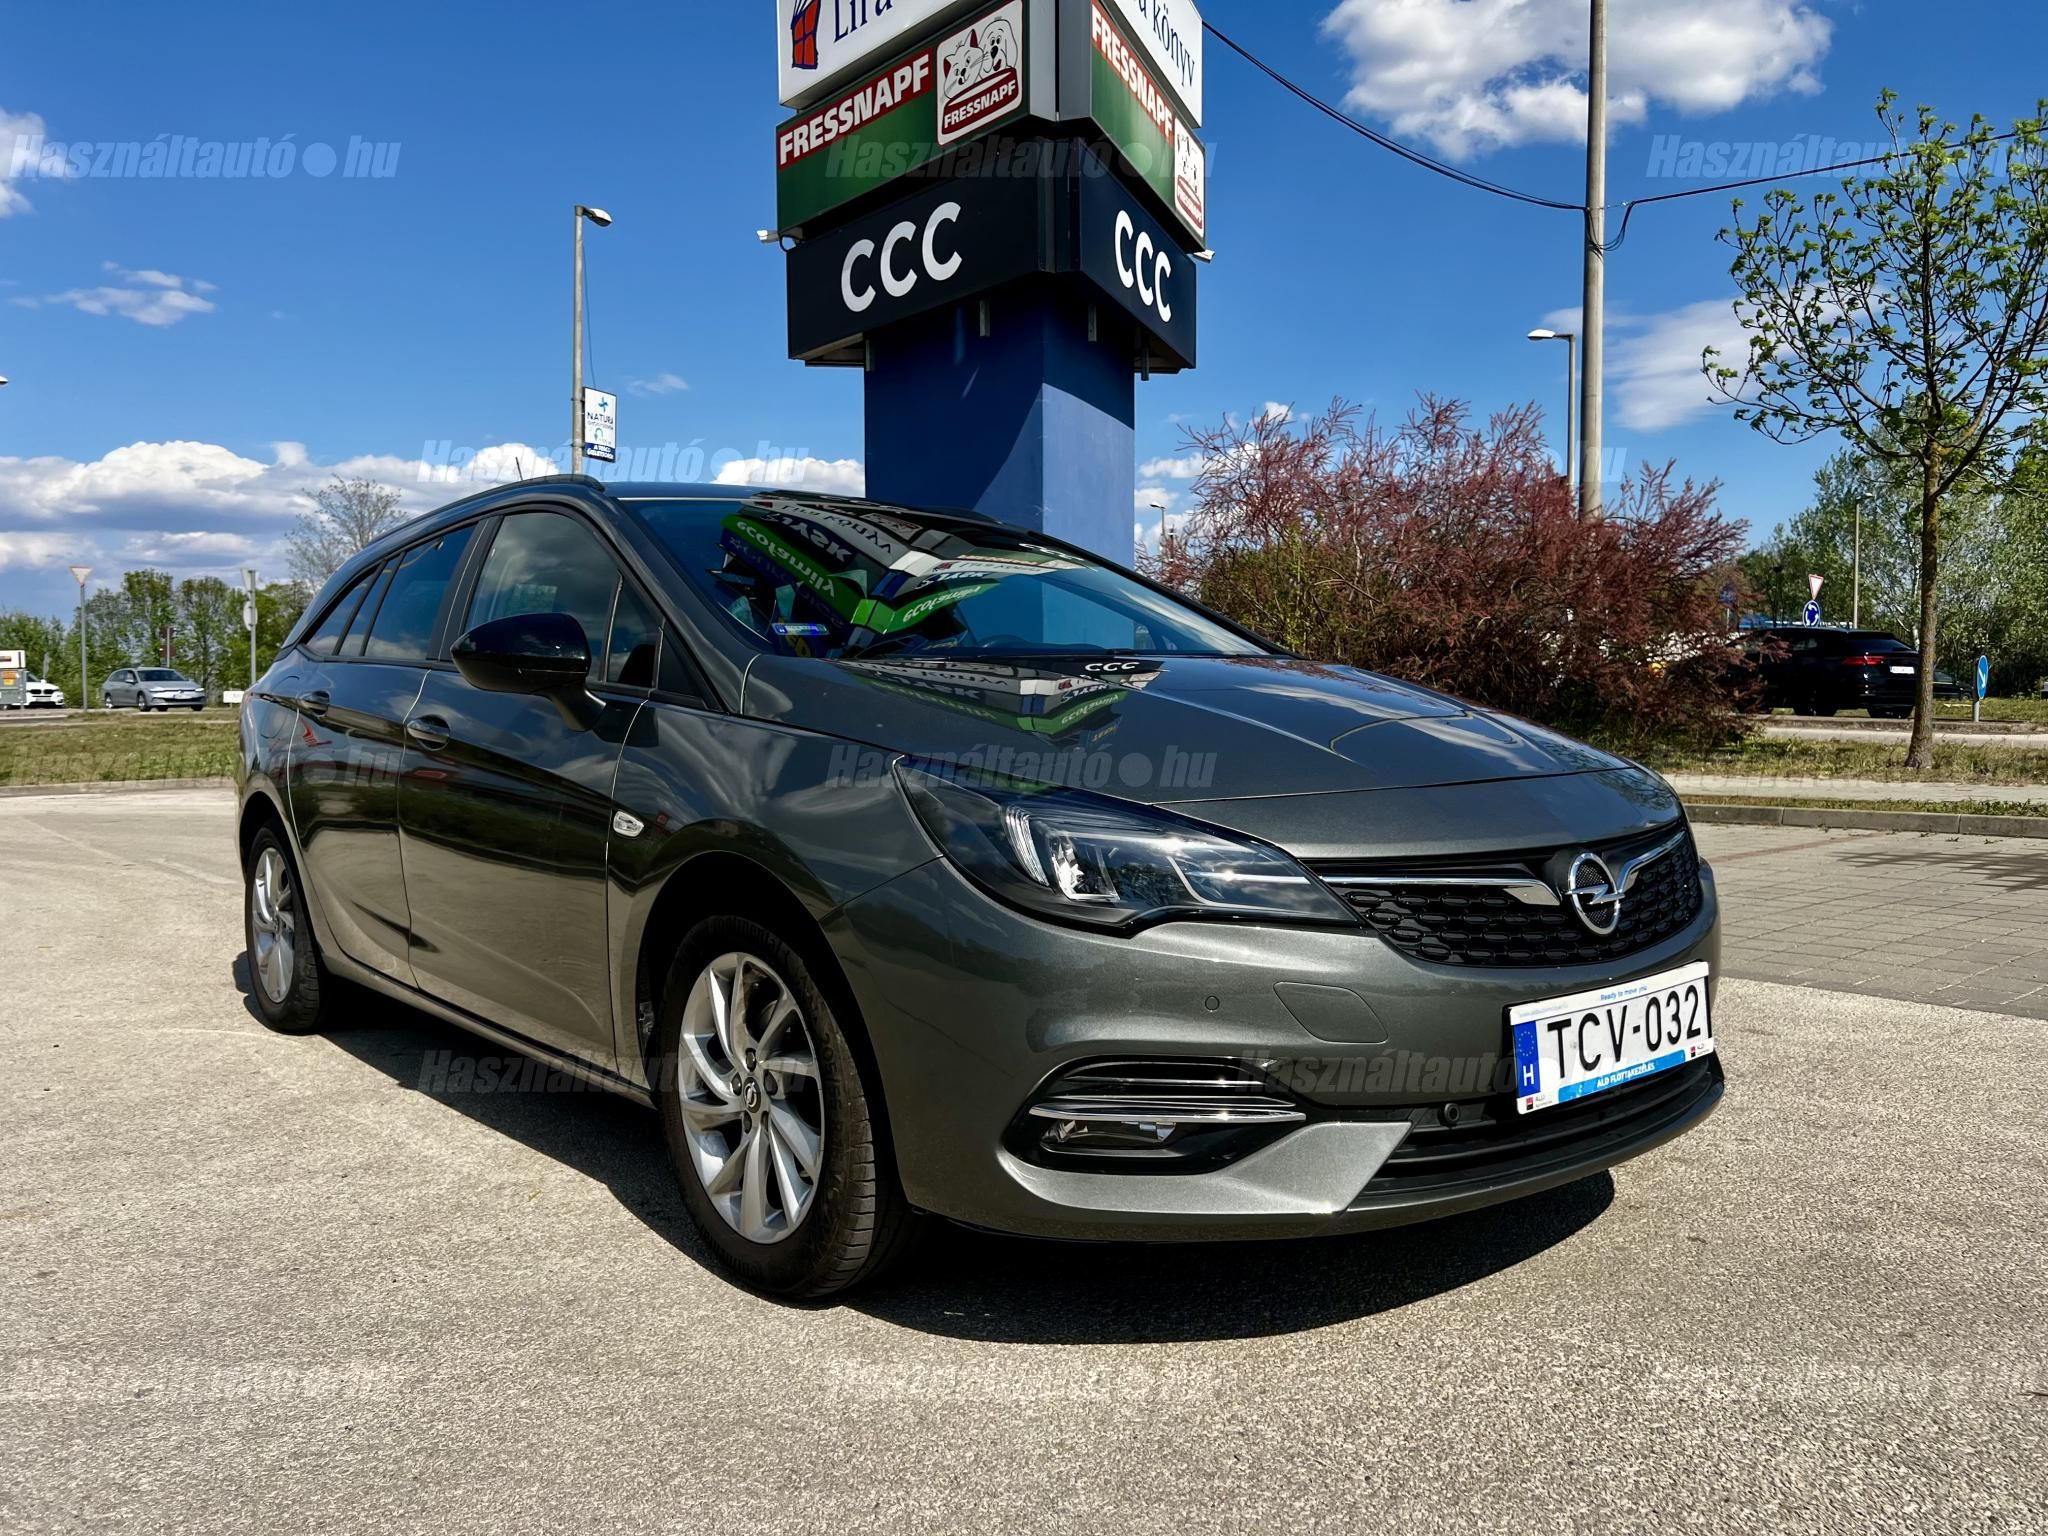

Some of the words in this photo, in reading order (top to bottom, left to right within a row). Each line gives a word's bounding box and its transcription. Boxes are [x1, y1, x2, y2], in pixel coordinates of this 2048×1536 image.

[779, 54, 931, 165] FRESSNAPF
[943, 79, 1017, 129] FRESSNAPF
[1092, 3, 1174, 138] FRESSNAPF
[840, 201, 963, 313] CCC
[1114, 210, 1172, 322] CCC
[1523, 1063, 1535, 1087] H
[1547, 984, 1701, 1078] TCV-032
